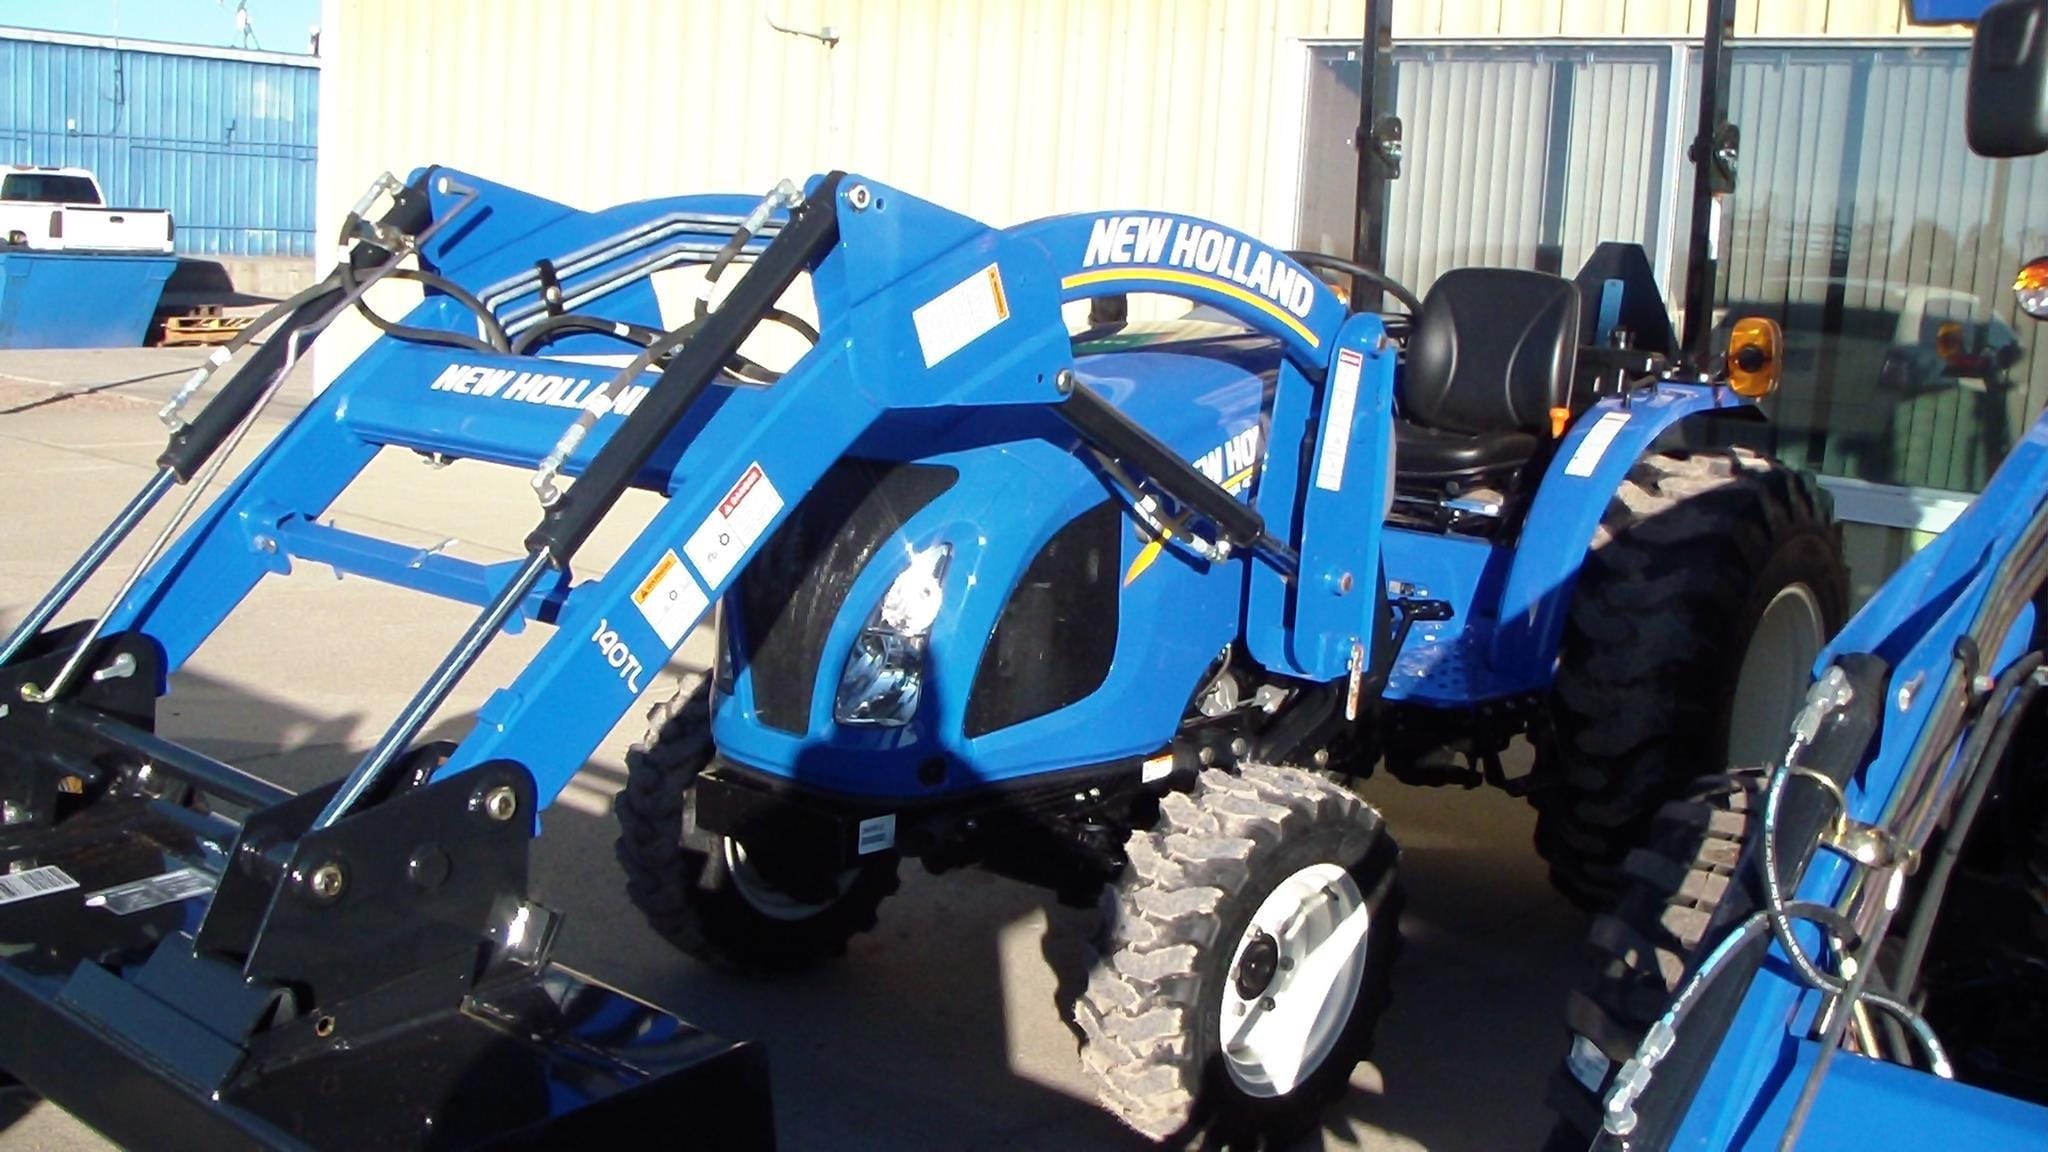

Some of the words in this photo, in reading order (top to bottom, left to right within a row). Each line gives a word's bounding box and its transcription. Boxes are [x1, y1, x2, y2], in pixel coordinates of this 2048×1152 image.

[1082, 217, 1173, 268] NEW
[1168, 223, 1315, 319] HOLLAND
[430, 364, 517, 397] NEW
[502, 371, 650, 417] HOLLAN
[591, 617, 643, 694] 140TL
